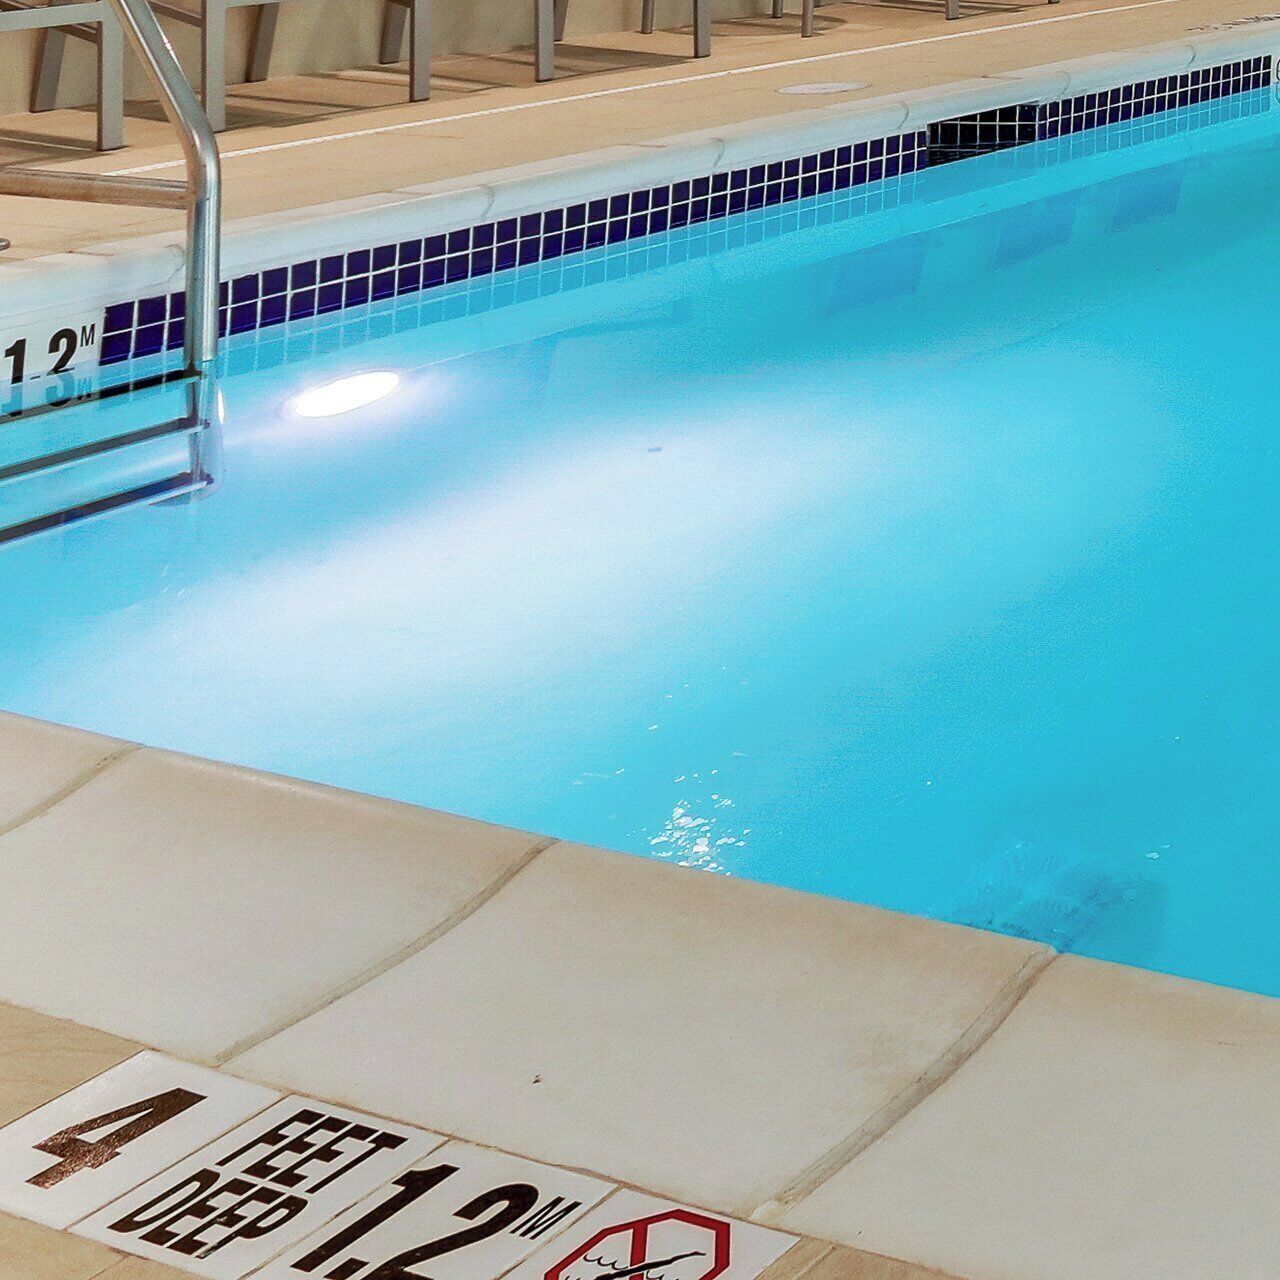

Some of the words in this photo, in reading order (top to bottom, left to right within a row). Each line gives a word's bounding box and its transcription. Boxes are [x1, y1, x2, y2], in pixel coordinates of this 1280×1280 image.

[25, 1087, 208, 1189] 4
[215, 1108, 409, 1194] FEET
[106, 1167, 309, 1259] DEEP
